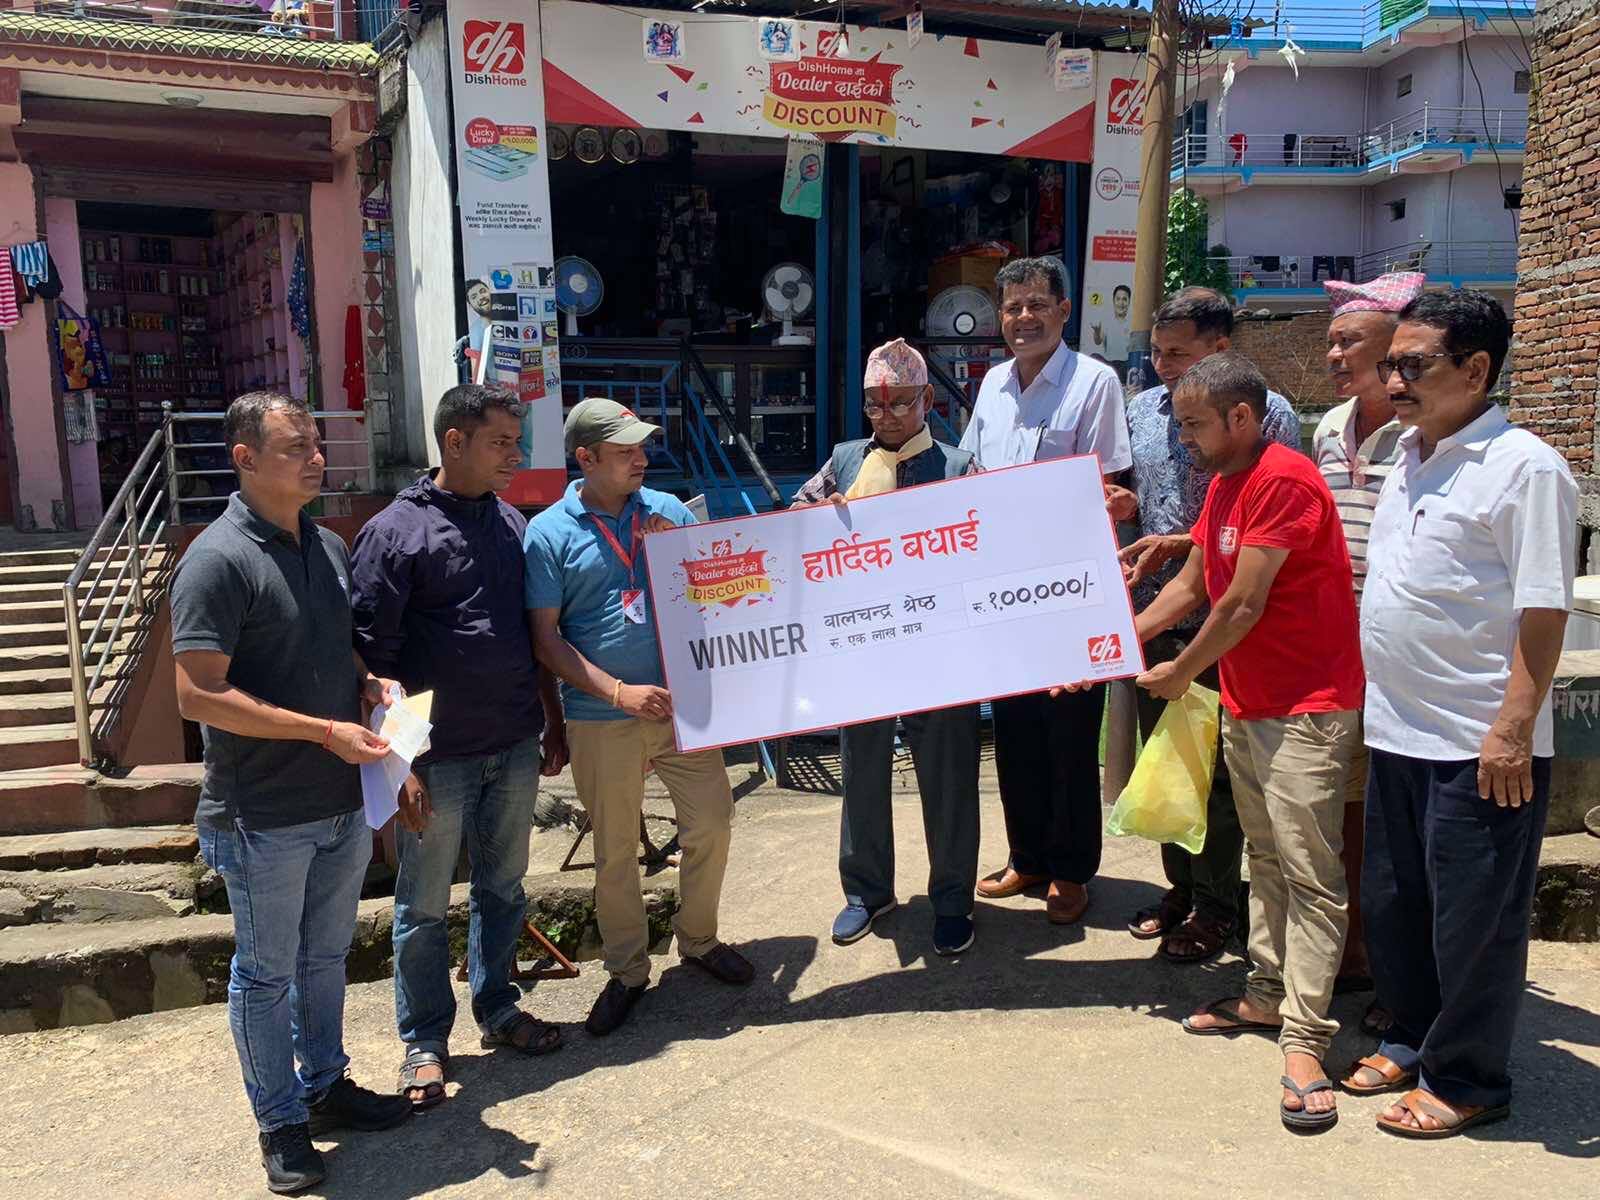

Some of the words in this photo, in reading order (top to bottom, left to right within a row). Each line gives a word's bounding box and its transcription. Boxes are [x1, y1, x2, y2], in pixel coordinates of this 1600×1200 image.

[798, 61, 853, 76] DishHome
[465, 73, 527, 87] DishHome
[777, 71, 832, 93] Dealer
[772, 101, 888, 127] DISCOUNT
[469, 127, 495, 137] Lucky
[1106, 124, 1143, 136] DishHo
[472, 136, 494, 144] Draw
[802, 532, 893, 582] हार्दिक
[900, 509, 980, 560] बधाई
[692, 569, 726, 581] Dealer
[693, 578, 764, 600] DISCOUNT
[847, 632, 866, 646] एक
[871, 626, 896, 641] लाख
[688, 622, 808, 671] WINNER
